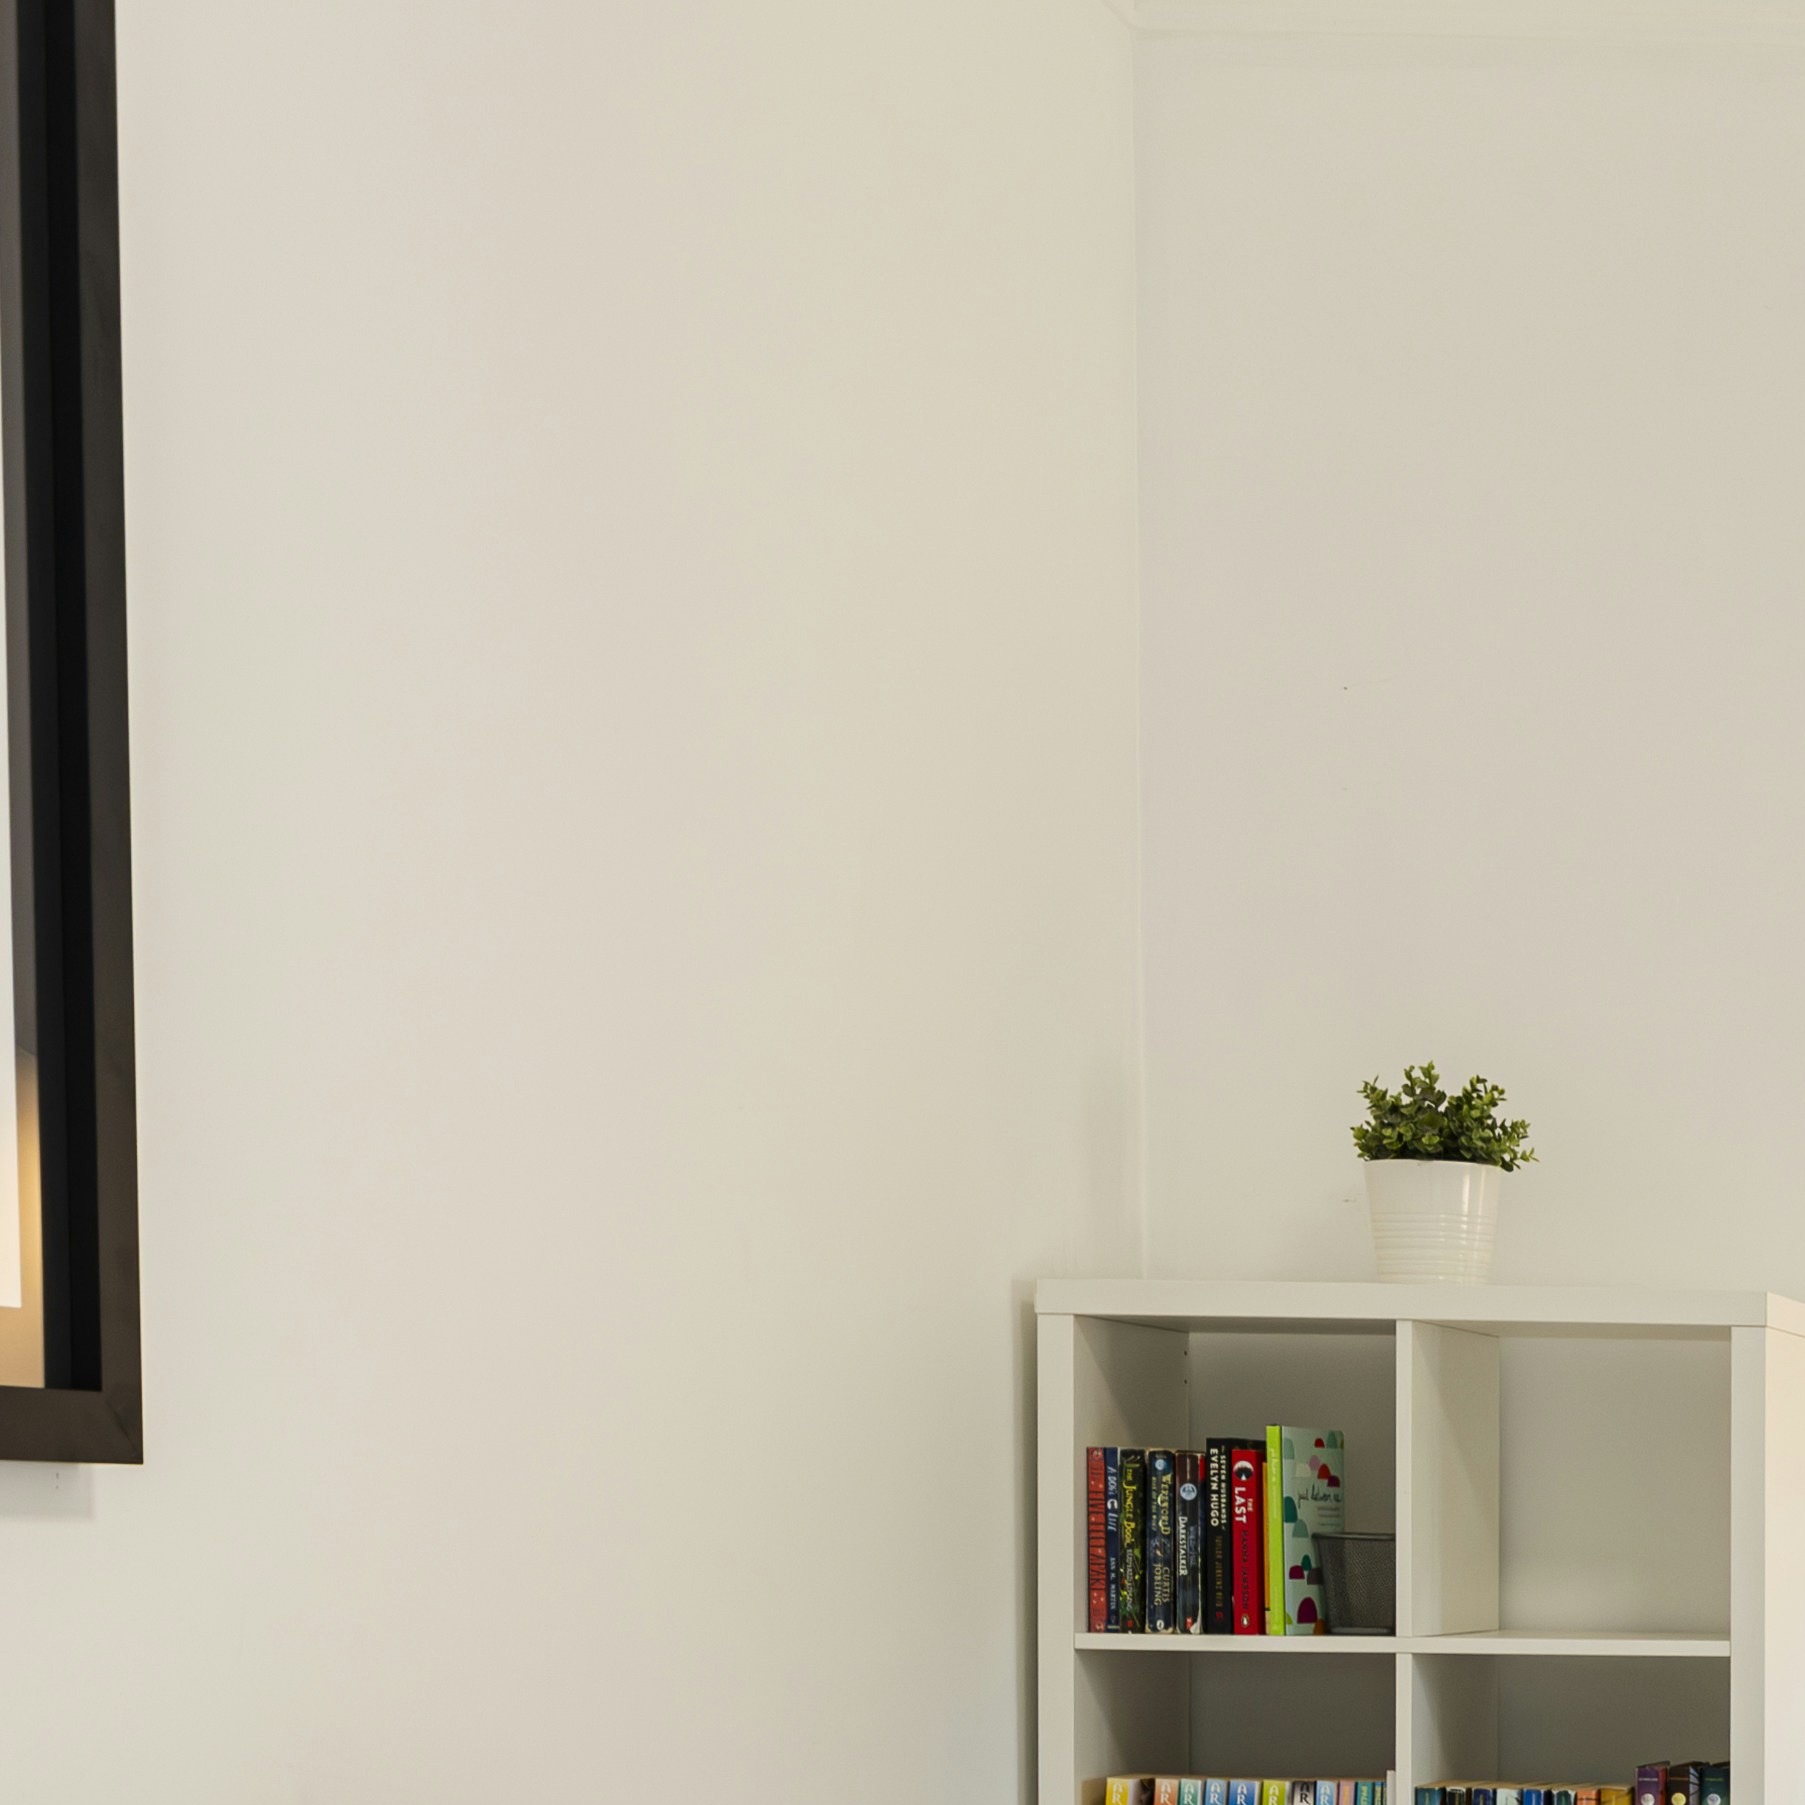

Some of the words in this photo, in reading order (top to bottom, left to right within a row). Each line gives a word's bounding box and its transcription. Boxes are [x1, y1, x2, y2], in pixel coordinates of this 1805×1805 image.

[1210, 1447, 1219, 1490] EVELYN
[1210, 1493, 1220, 1527] HUGO
[1234, 1486, 1247, 1524] LAST
[1178, 1516, 1188, 1576] DARKSTALKER
[1152, 1563, 1163, 1606] JOBLING
[1162, 1566, 1170, 1603] CURTIS
